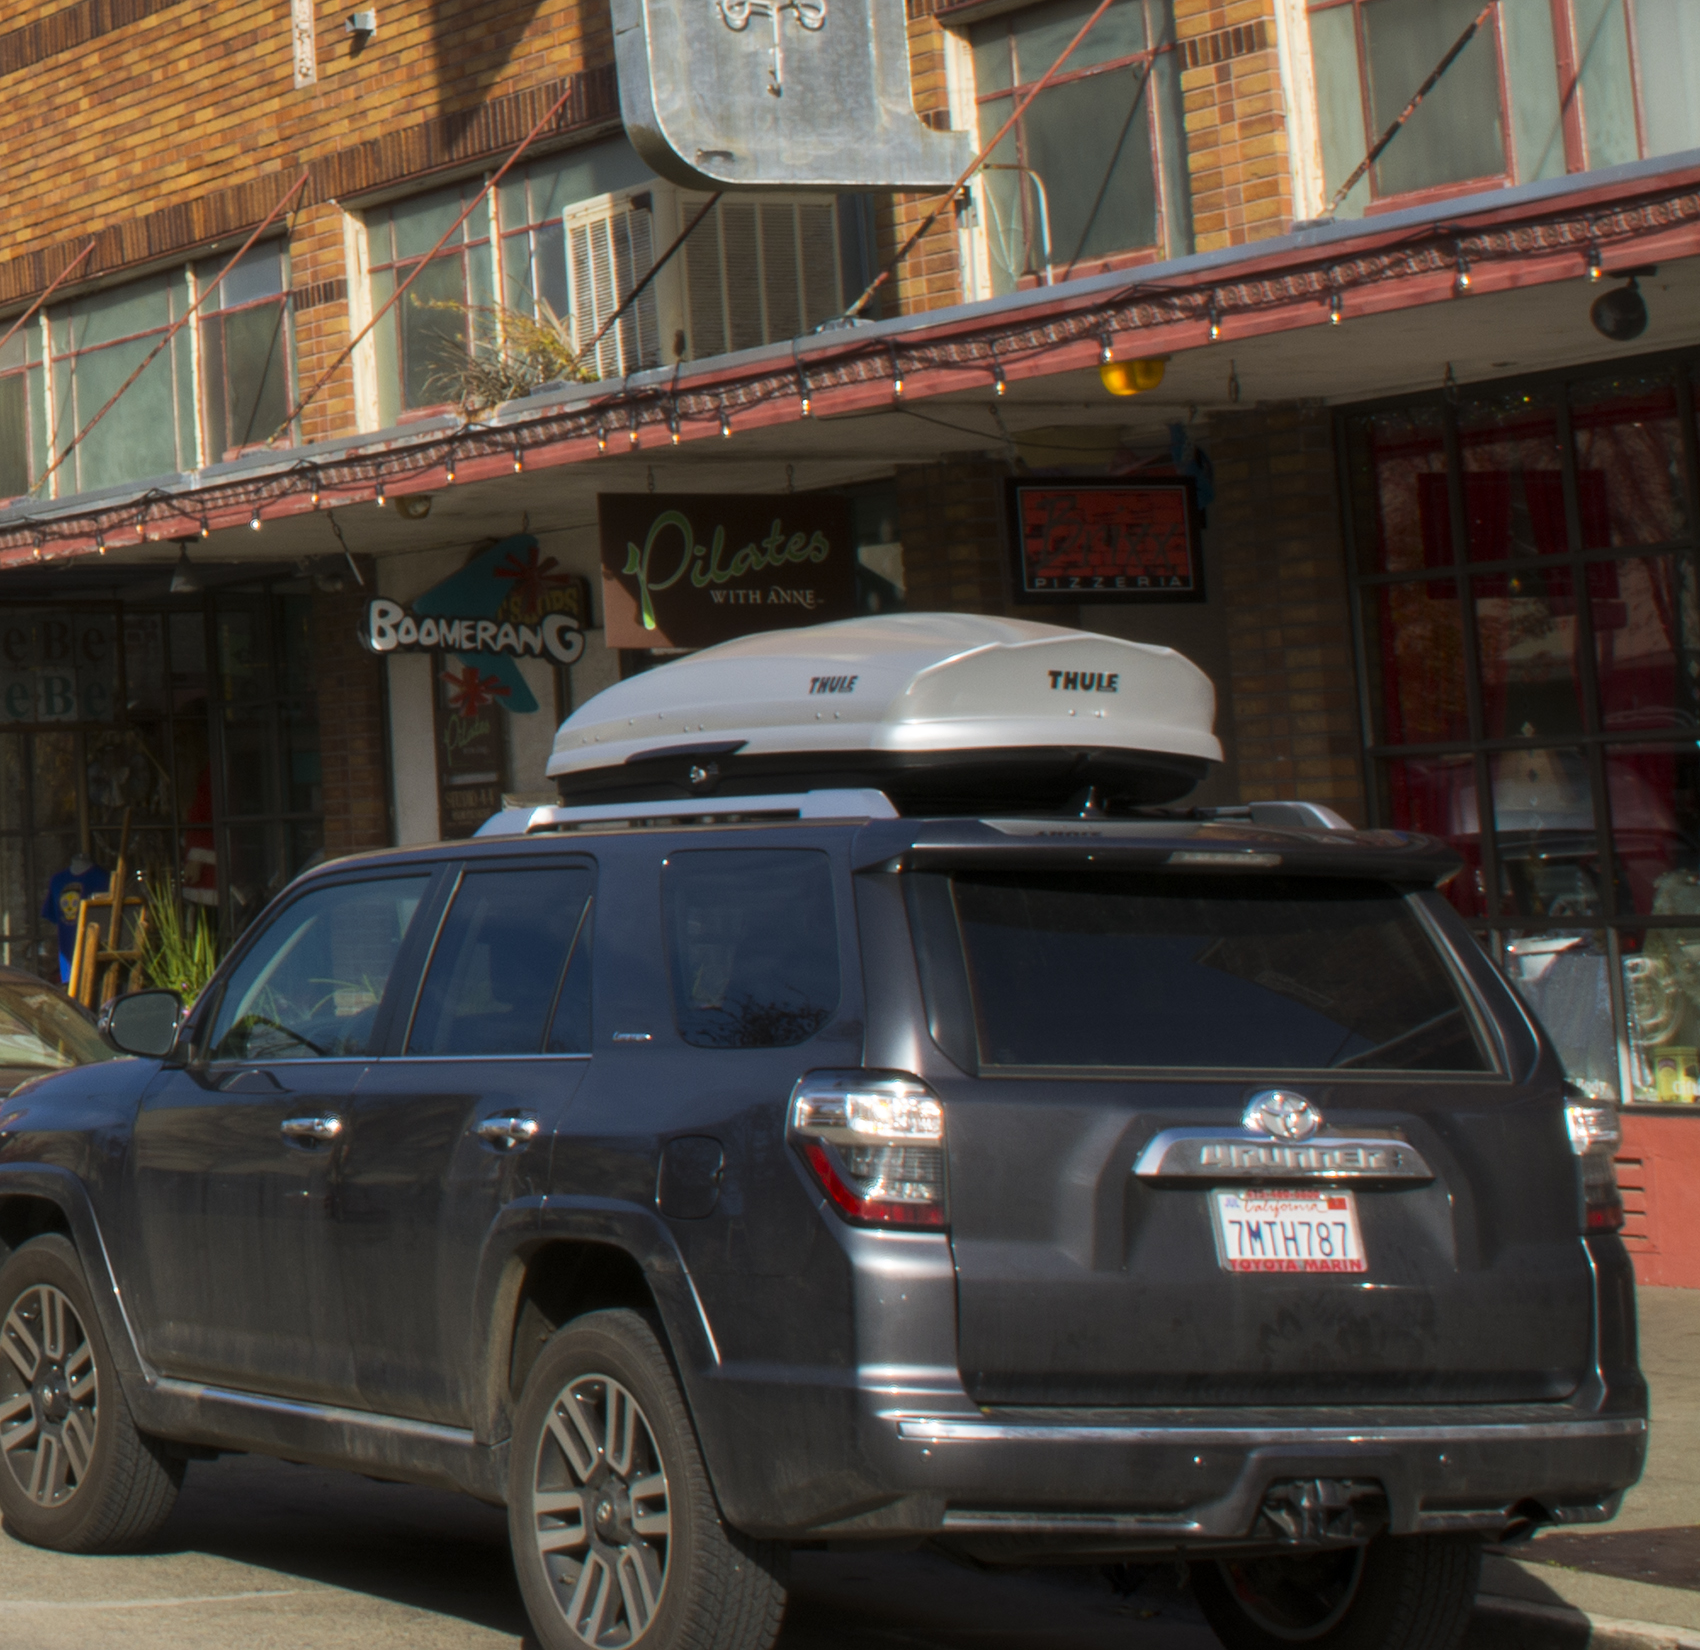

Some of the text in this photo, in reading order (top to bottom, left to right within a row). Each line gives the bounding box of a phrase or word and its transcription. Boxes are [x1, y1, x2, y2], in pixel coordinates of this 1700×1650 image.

[622, 510, 830, 630] Pilates
[1034, 576, 1182, 589] PIZZERIA
[710, 586, 817, 610] WITH ANNE
[369, 599, 585, 664] BOOMERANG
[808, 675, 858, 694] THULE
[1048, 670, 1119, 693] THULE
[1244, 1200, 1328, 1218] California
[1228, 1219, 1348, 1257] 7MTH787
[1230, 1259, 1363, 1272] TOYOTA MARIN
